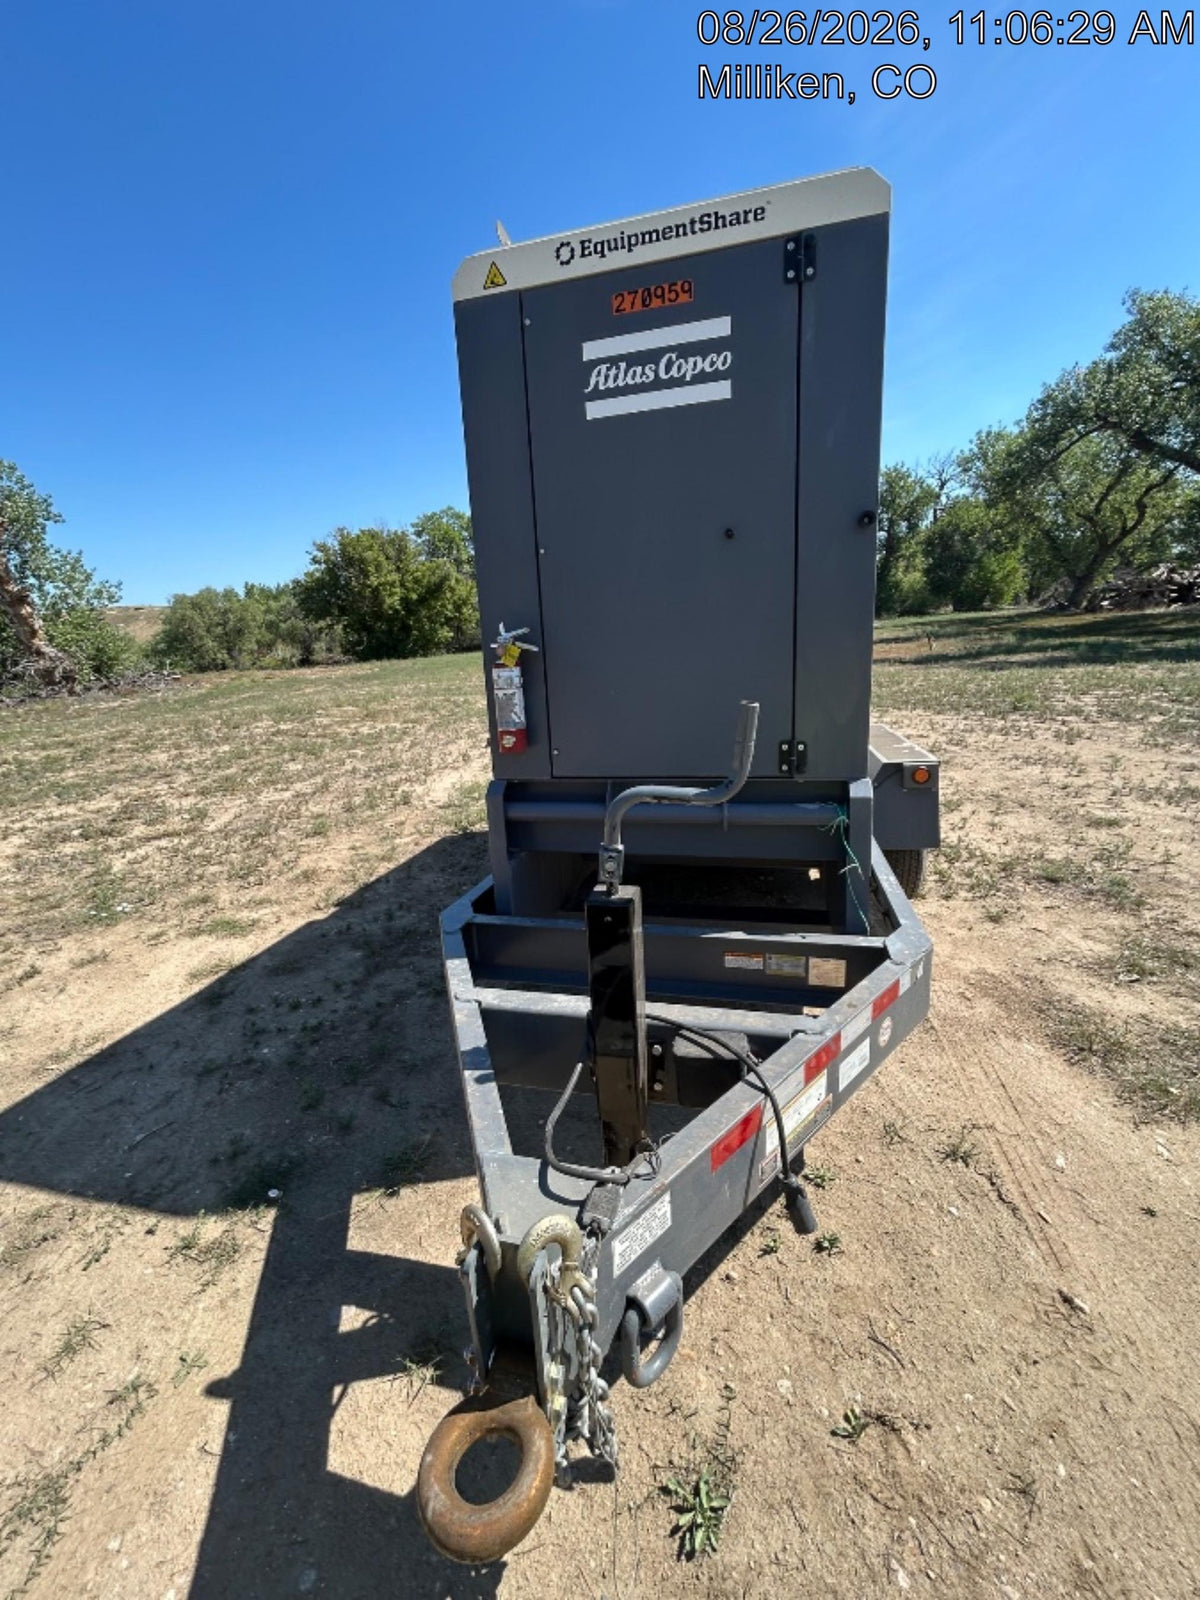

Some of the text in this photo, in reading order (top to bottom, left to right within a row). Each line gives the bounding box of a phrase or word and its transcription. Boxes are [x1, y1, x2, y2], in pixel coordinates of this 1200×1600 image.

[578, 205, 767, 259] EquipmentShare
[613, 280, 694, 314] 270959
[583, 351, 733, 394] Atlas Copco
